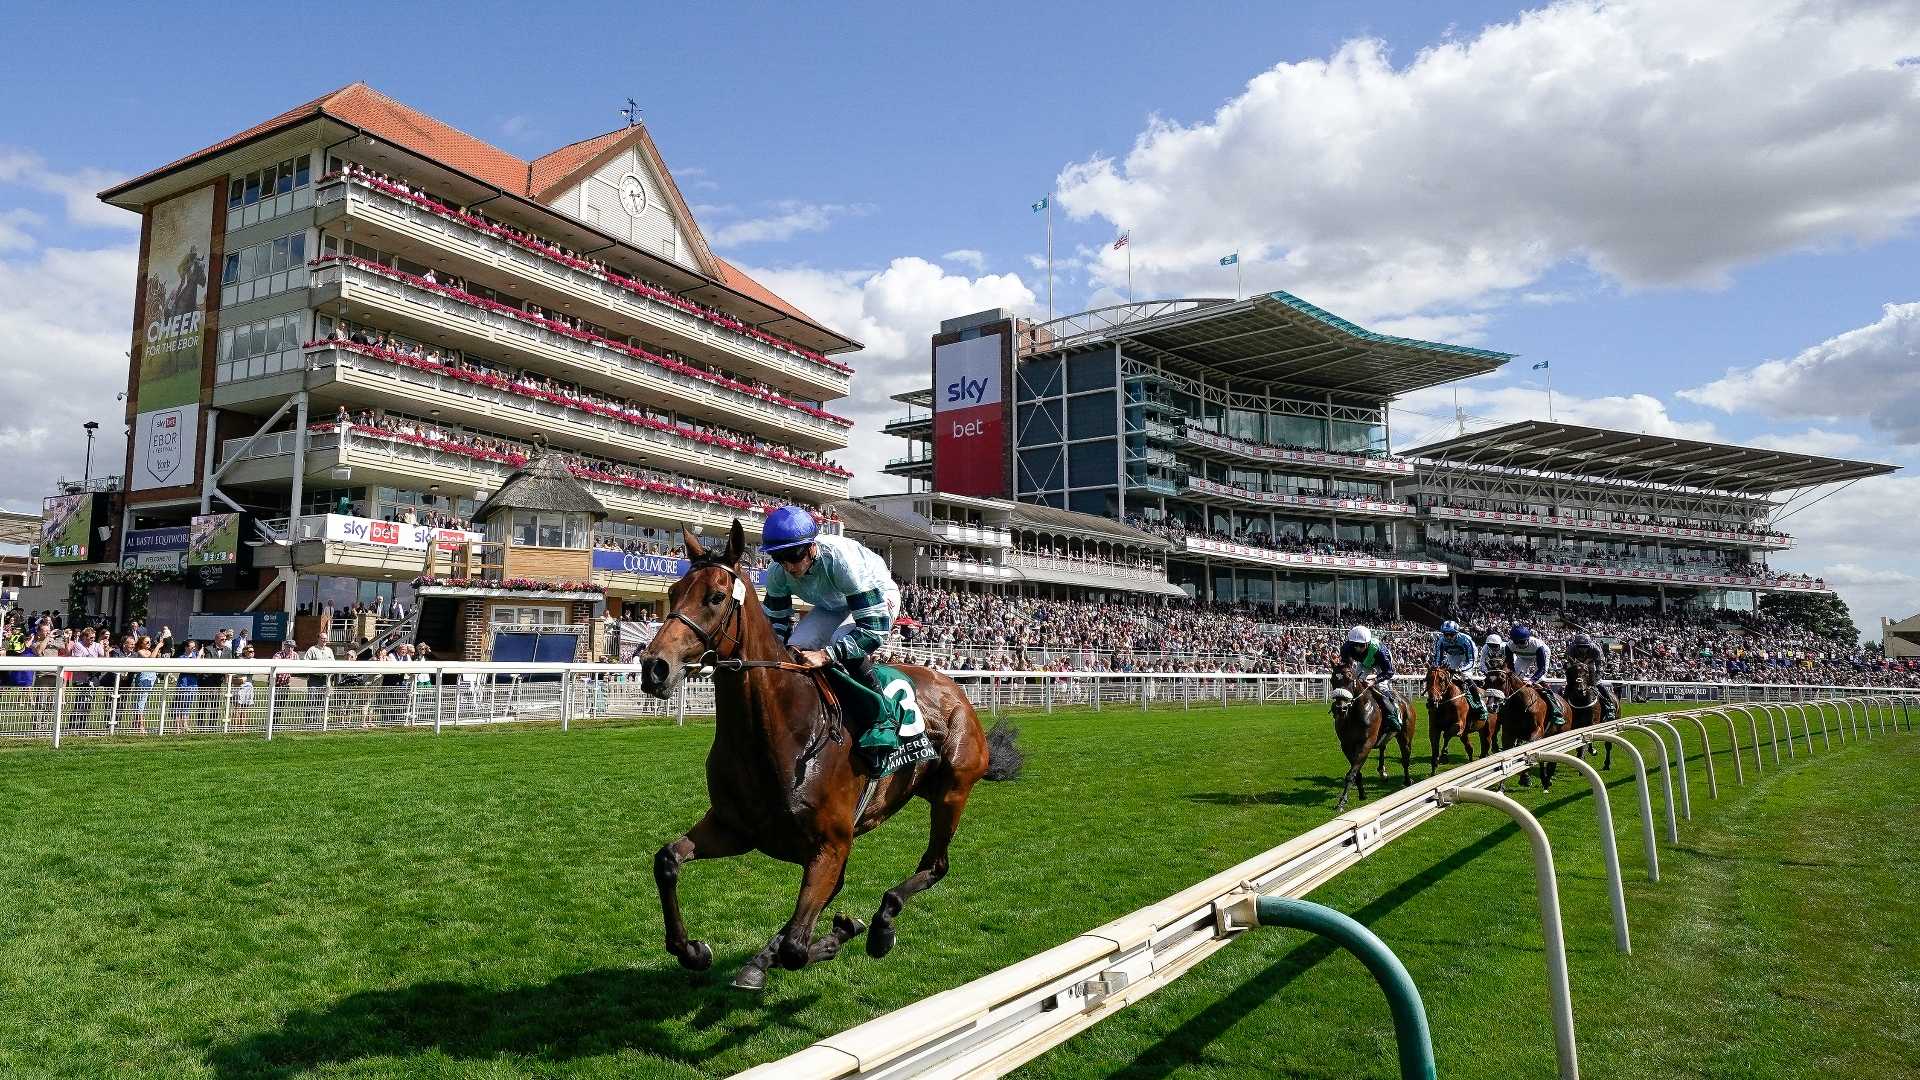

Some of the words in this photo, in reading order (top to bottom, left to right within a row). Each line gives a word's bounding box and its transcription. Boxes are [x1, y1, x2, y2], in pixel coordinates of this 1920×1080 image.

[147, 310, 200, 342] CHEER
[146, 344, 160, 358] FOR
[162, 340, 176, 354] THE
[178, 336, 199, 350] EBOR
[948, 376, 988, 403] sky
[953, 419, 983, 438] bet
[154, 432, 177, 447] EBOR
[126, 538, 135, 546] AL
[136, 536, 154, 546] BASTI
[156, 534, 190, 546] EQUIWORL
[344, 520, 368, 539] sky
[372, 523, 397, 540] bet
[624, 554, 678, 574] COOLMORE
[883, 679, 925, 737] 3
